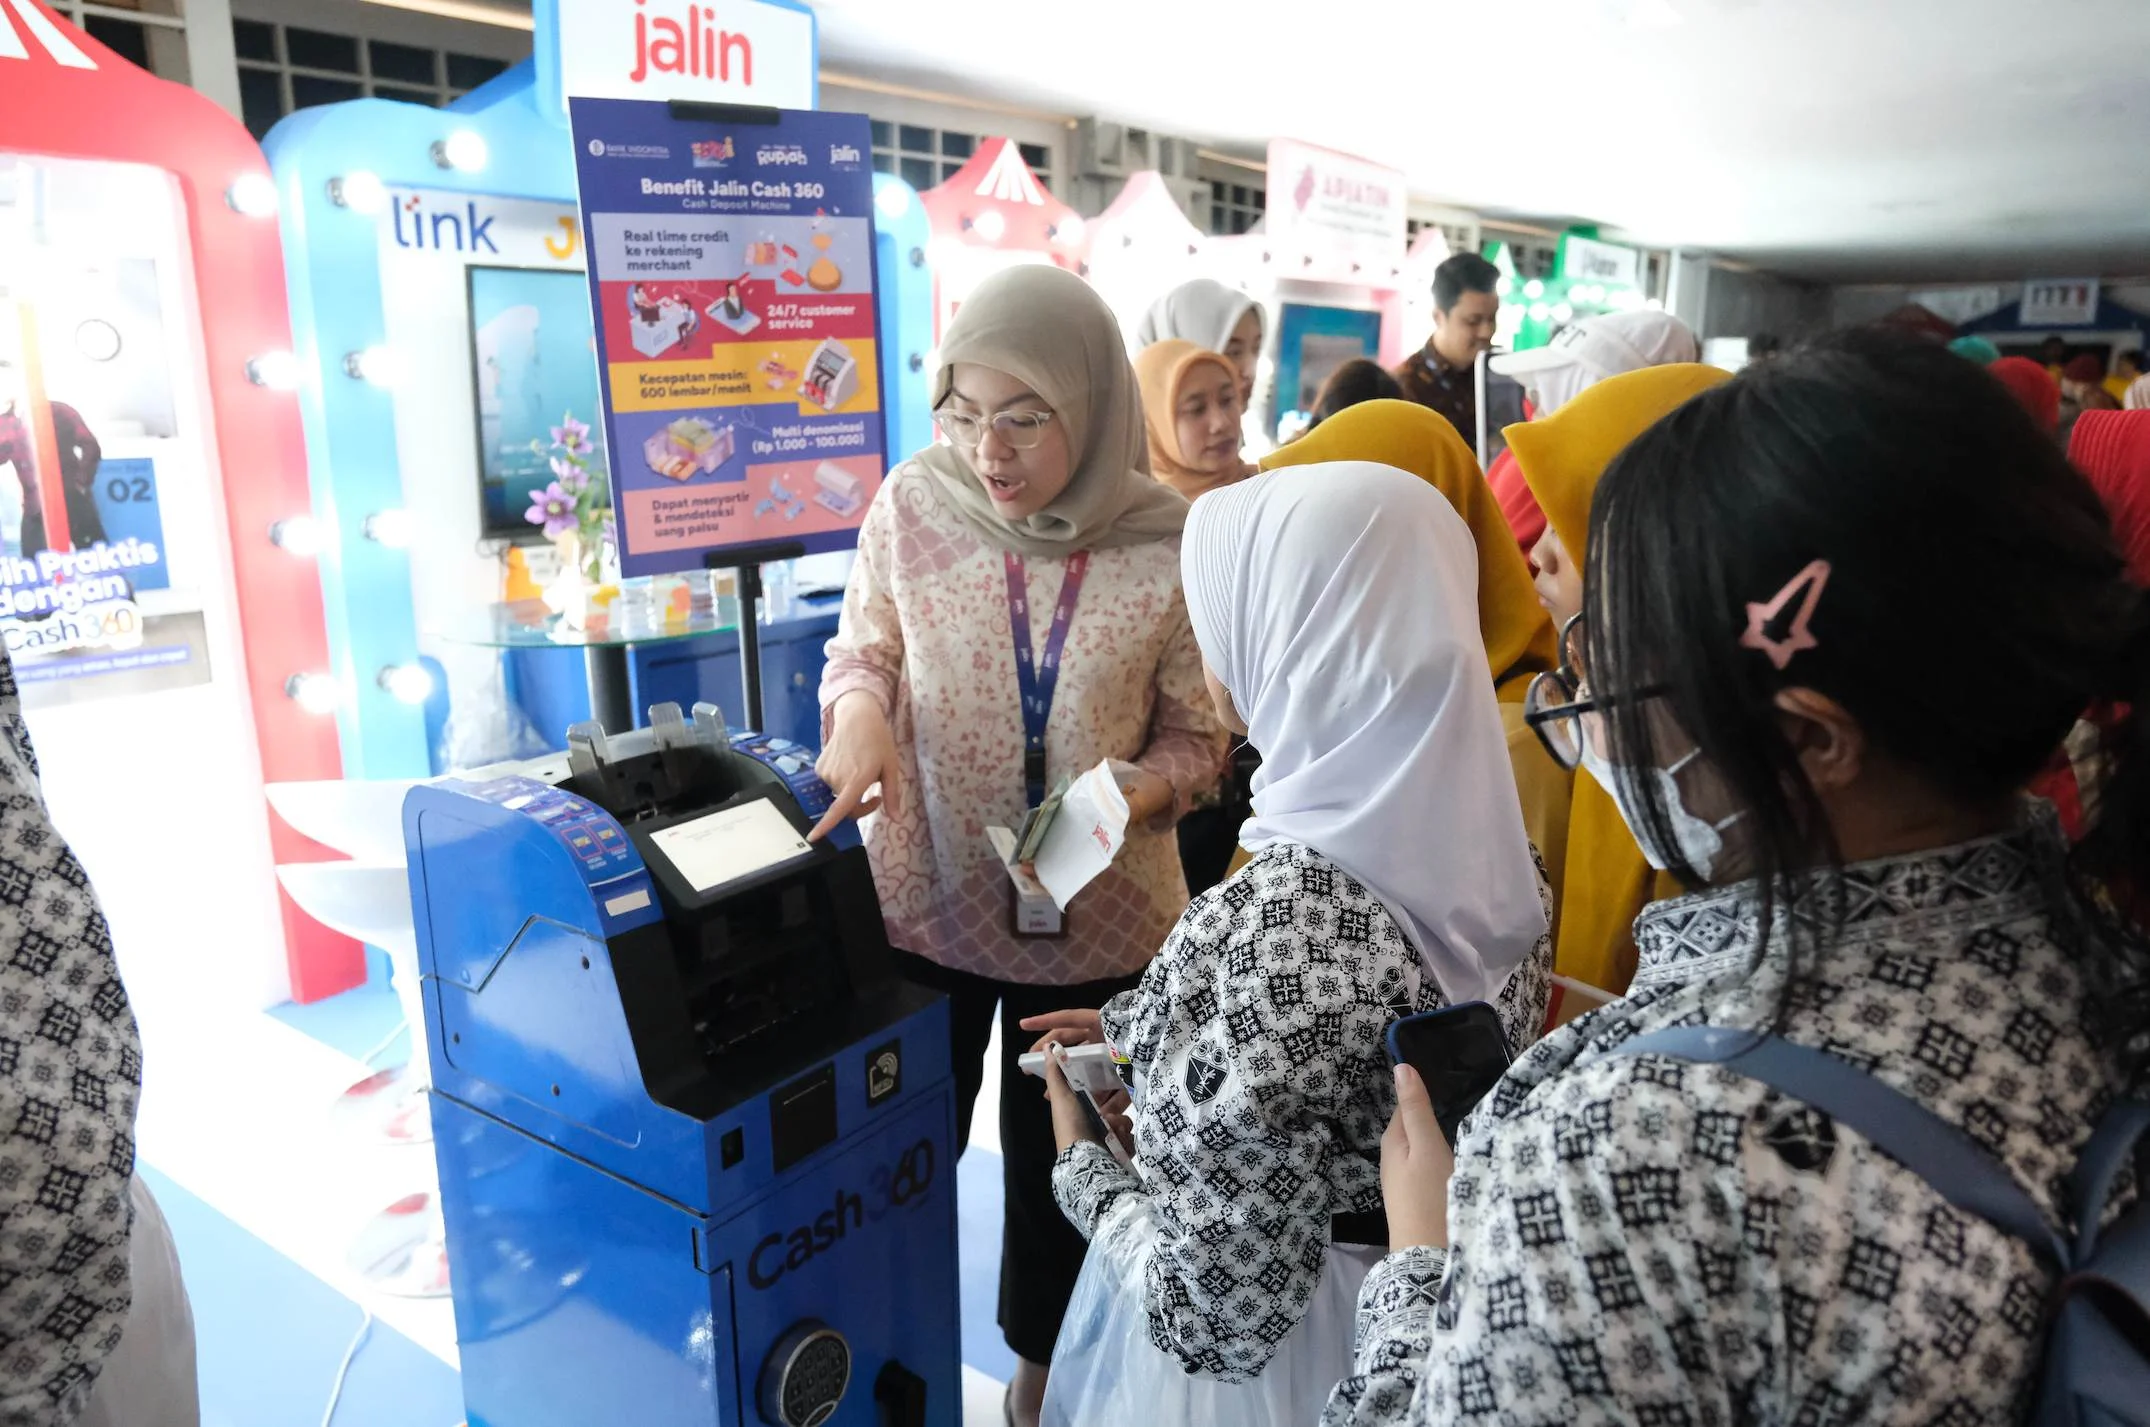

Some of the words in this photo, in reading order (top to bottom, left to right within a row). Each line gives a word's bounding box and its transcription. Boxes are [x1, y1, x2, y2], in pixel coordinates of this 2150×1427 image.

[630, 0, 752, 87] jalin
[829, 144, 860, 165] jalin
[640, 177, 704, 195] Benefit
[708, 179, 748, 197] Jalin
[751, 181, 791, 198] Cash
[793, 183, 825, 199] 360
[681, 198, 709, 209] Cash
[710, 200, 748, 212] Deposit
[751, 201, 791, 212] Machine
[393, 195, 499, 254] link
[623, 229, 653, 242] Real
[656, 230, 687, 242] time
[690, 230, 729, 242] credit
[624, 244, 642, 257] ke
[644, 244, 703, 260] rekening
[626, 259, 692, 271] merchant
[767, 304, 798, 318] 24/7
[799, 304, 856, 317] customer
[767, 316, 814, 330] service
[639, 371, 706, 385] Kecepatan
[708, 369, 748, 382] mesin:
[640, 386, 667, 399] 600
[668, 382, 752, 397] lembar/menit
[772, 424, 802, 439] Multi
[803, 420, 864, 437] denominasi
[752, 440, 773, 455] (Rp
[775, 438, 807, 452] 1.000
[816, 433, 865, 449] 100.000)
[106, 476, 153, 504] 02
[652, 498, 688, 511] Dapat
[690, 490, 750, 508] menyortir
[654, 513, 662, 525] &
[664, 504, 735, 523] mendeteksi
[654, 525, 685, 539] uang
[687, 521, 720, 537] palsu
[37, 537, 159, 581] Praktis
[1091, 821, 1111, 854] jalin
[747, 1188, 863, 1290] Cash
